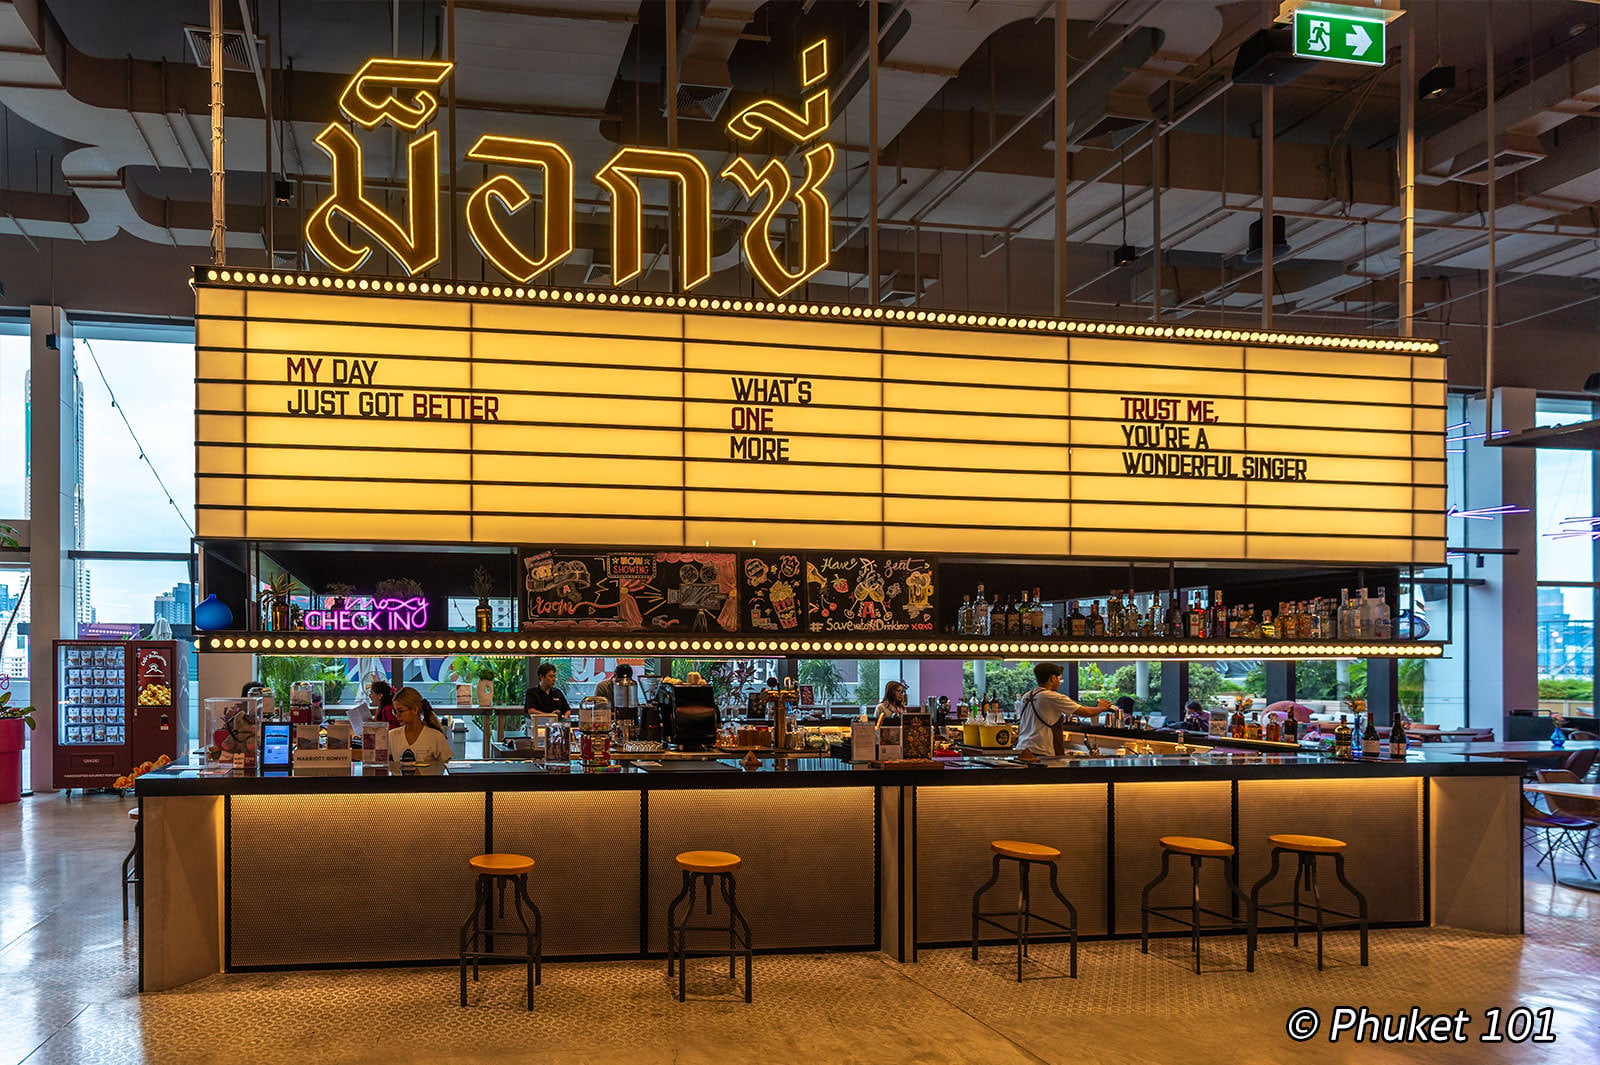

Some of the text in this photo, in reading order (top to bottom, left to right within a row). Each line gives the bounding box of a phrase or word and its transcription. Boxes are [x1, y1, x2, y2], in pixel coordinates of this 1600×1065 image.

[287, 357, 378, 385] MY DAY
[731, 376, 812, 404] WHAT'S
[288, 389, 499, 421] JUST GOT BETTER
[1120, 397, 1219, 423] TRUST ME,
[731, 407, 773, 431] ONE
[730, 436, 789, 462] MORE
[1121, 423, 1209, 450] YOU'RE A
[1122, 452, 1307, 481] WONDERFUL SINGER
[613, 565, 649, 575] SHOWING
[620, 557, 643, 565] NOW
[821, 558, 858, 573] Have
[304, 611, 411, 631] CHECK IN
